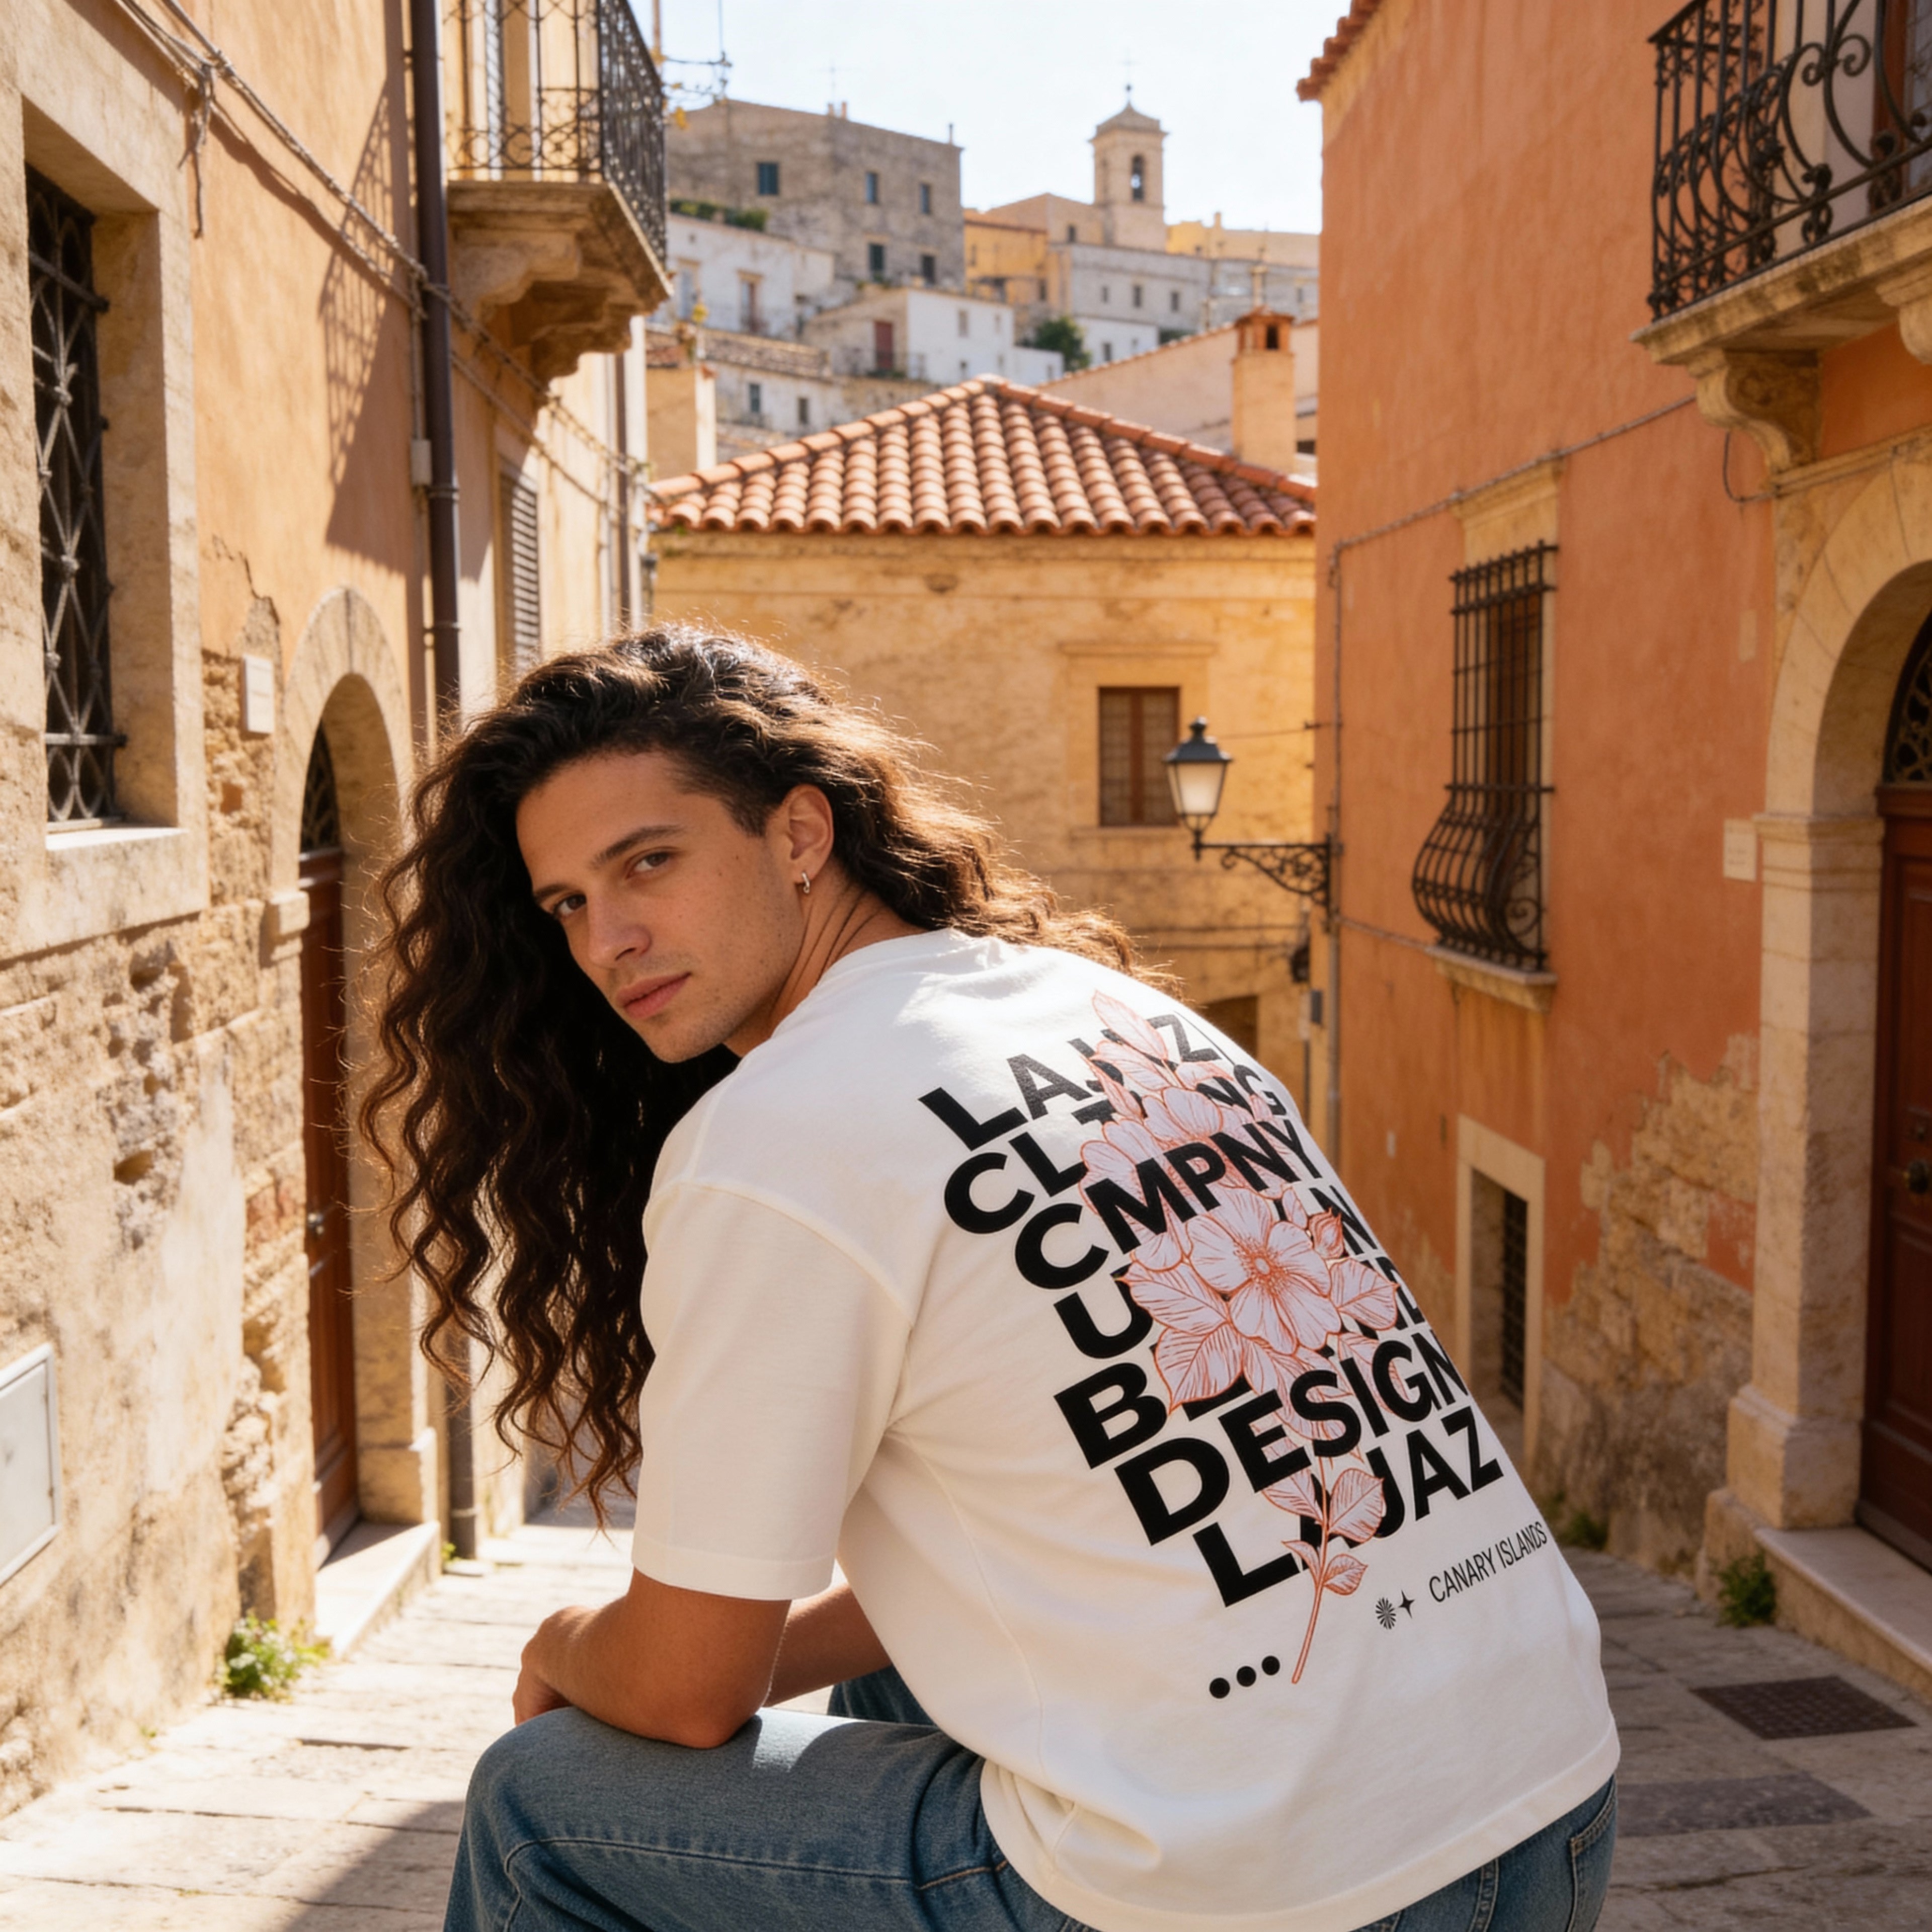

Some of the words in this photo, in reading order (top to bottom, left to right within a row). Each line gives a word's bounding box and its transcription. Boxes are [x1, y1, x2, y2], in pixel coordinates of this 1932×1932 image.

[1015, 1120, 1322, 1290] CMPNY
[1114, 1329, 1469, 1546] DESIGN
[1429, 1547, 1497, 1602] CANARY
[1495, 1521, 1548, 1569] ISLANDS
